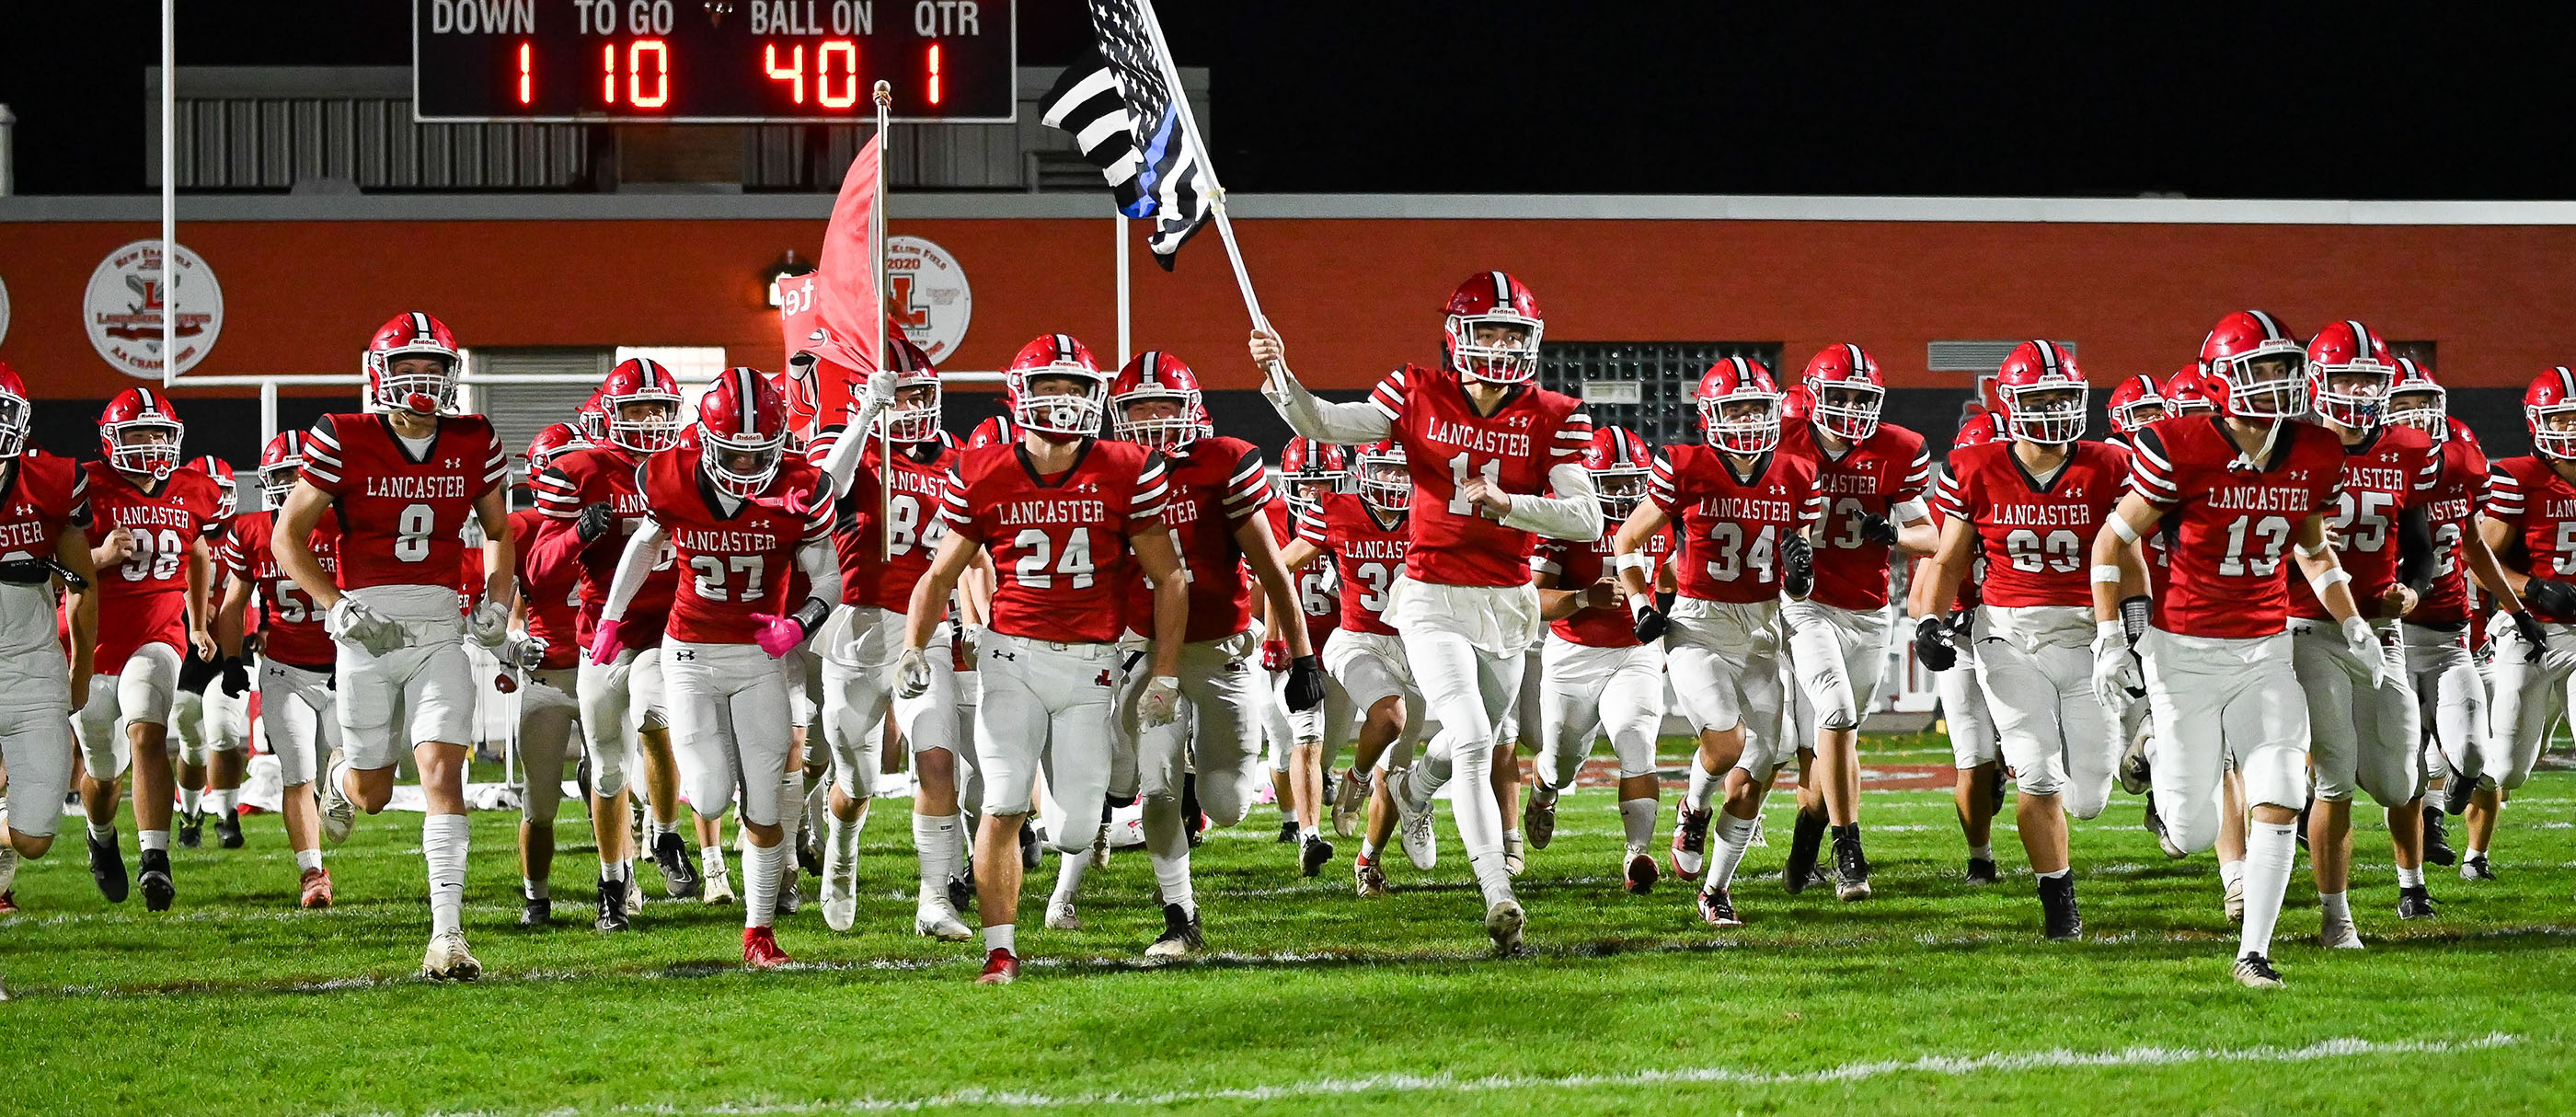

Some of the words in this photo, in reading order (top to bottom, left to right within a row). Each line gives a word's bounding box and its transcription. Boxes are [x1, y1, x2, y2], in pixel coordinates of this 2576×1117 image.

[432, 0, 535, 34] DOWN
[574, 0, 615, 35] TO
[629, 0, 673, 35] GO
[751, 0, 823, 35] BALL
[833, 0, 872, 36] ON
[914, 1, 979, 38] QTR
[520, 42, 531, 103] 1
[604, 40, 668, 108] 10
[765, 40, 856, 108] 40
[928, 44, 939, 104] 1
[887, 258, 921, 271] 2020
[1426, 416, 1530, 457] LANCASTER
[367, 476, 465, 499] LANCASTER
[2208, 486, 2309, 512] LANCASTER
[112, 506, 190, 530] LANCASTER
[890, 494, 949, 561] 84
[996, 500, 1105, 525] LANCASTER
[1698, 496, 1790, 522] LANCASTER
[1993, 503, 2090, 525] LANCASTER
[2325, 491, 2394, 553] 25
[395, 503, 435, 562] 8
[676, 527, 776, 552] LANCASTER
[1706, 522, 1777, 583] 34
[2217, 514, 2292, 576] 13
[121, 528, 182, 582] 98
[1013, 527, 1095, 589] 24
[690, 554, 765, 603] 27
